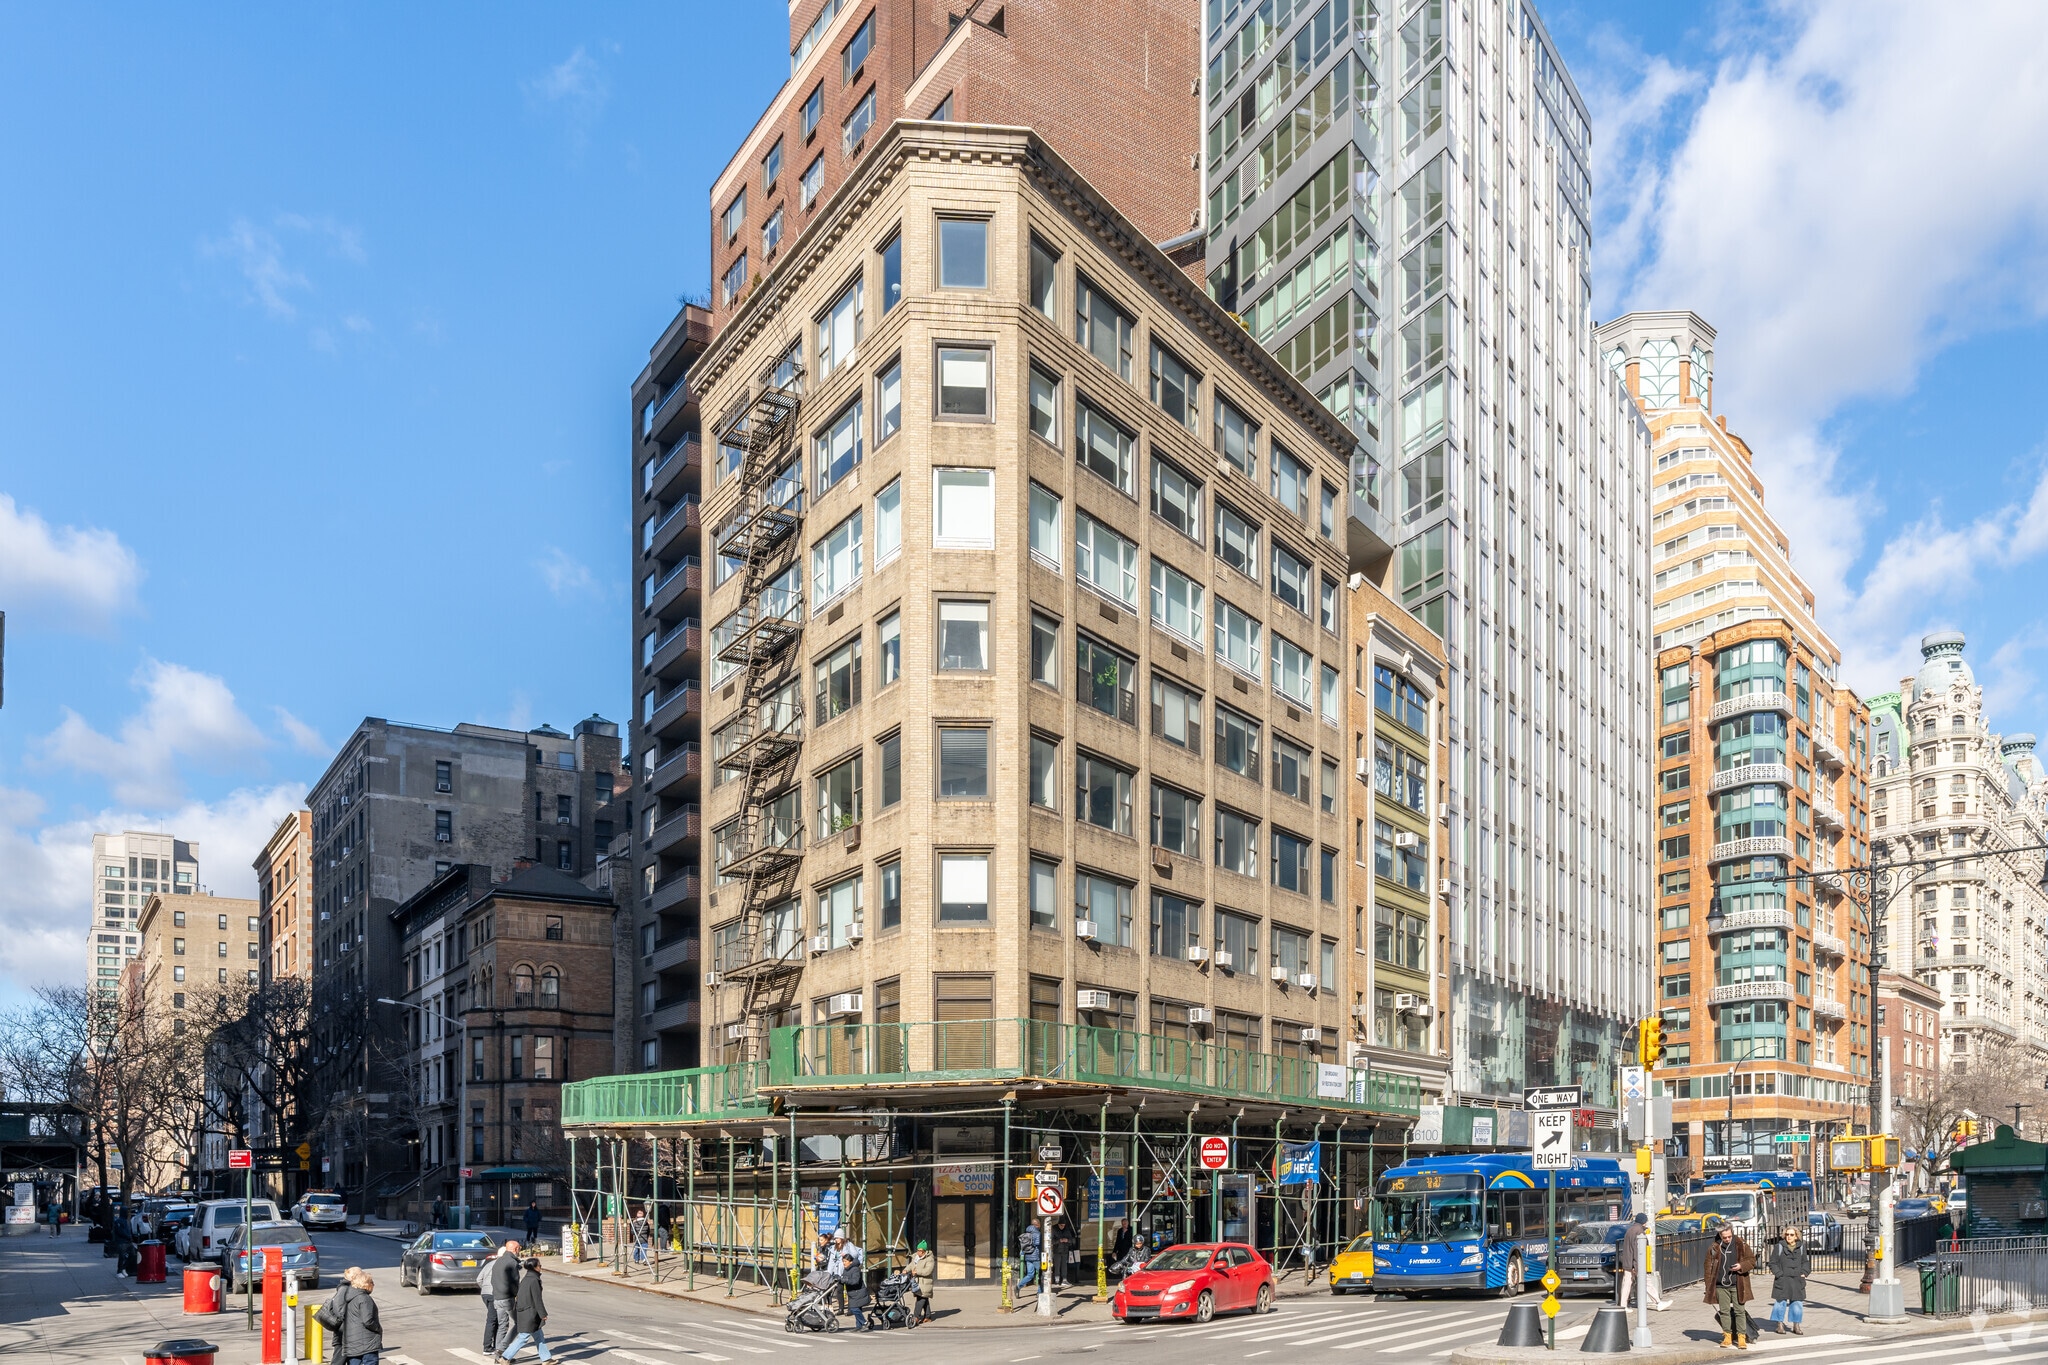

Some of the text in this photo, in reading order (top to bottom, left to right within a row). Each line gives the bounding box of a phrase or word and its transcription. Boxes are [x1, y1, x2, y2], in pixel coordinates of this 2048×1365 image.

[1532, 1093, 1574, 1104] ONE WAY
[1538, 1115, 1566, 1127] KEEP
[1294, 1151, 1315, 1162] PLAY
[1536, 1153, 1568, 1165] RIGHT
[964, 1164, 972, 1174] &
[1293, 1163, 1318, 1174] HERE.
[964, 1183, 993, 1191] SOON
[1112, 1188, 1125, 1196] Lease
